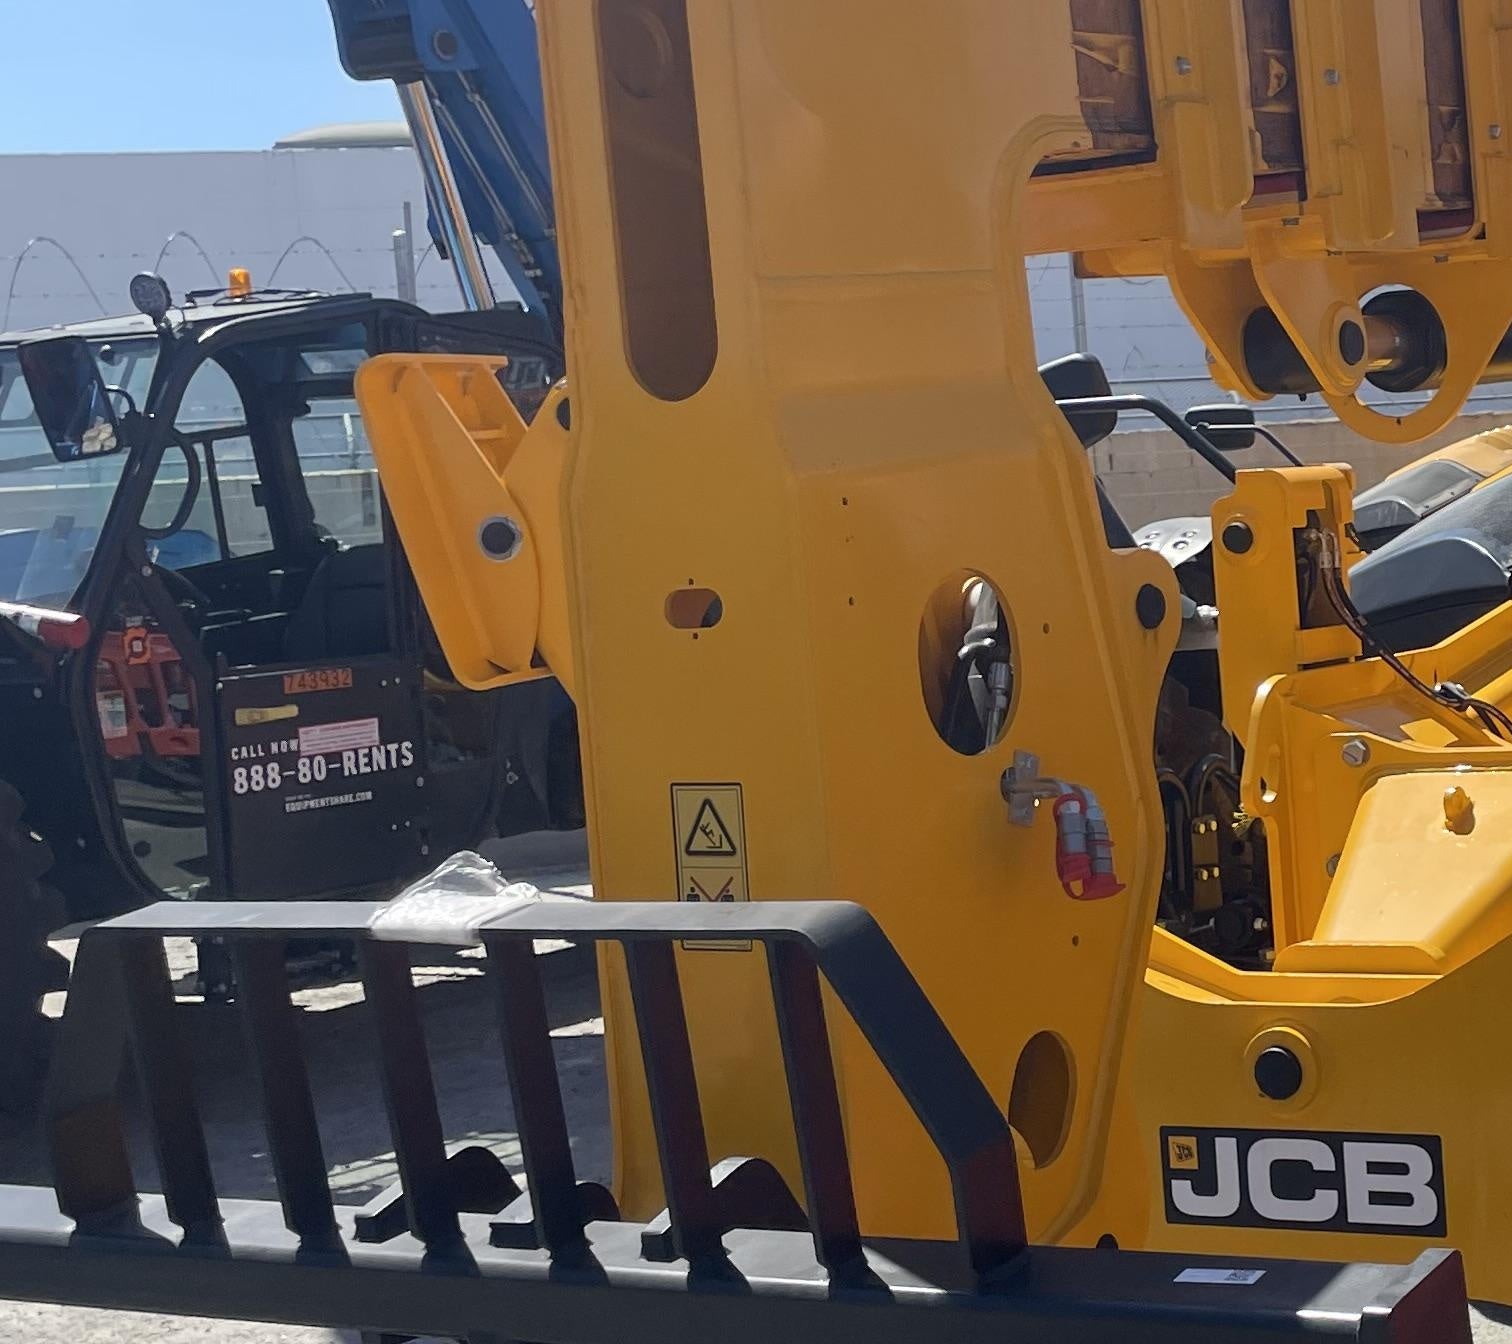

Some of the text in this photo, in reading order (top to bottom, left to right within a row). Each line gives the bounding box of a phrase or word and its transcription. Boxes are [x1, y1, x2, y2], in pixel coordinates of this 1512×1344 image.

[231, 739, 300, 761] CALL NOW
[233, 741, 414, 795] 888-80-RENTS
[1171, 1136, 1439, 1227] JCB
